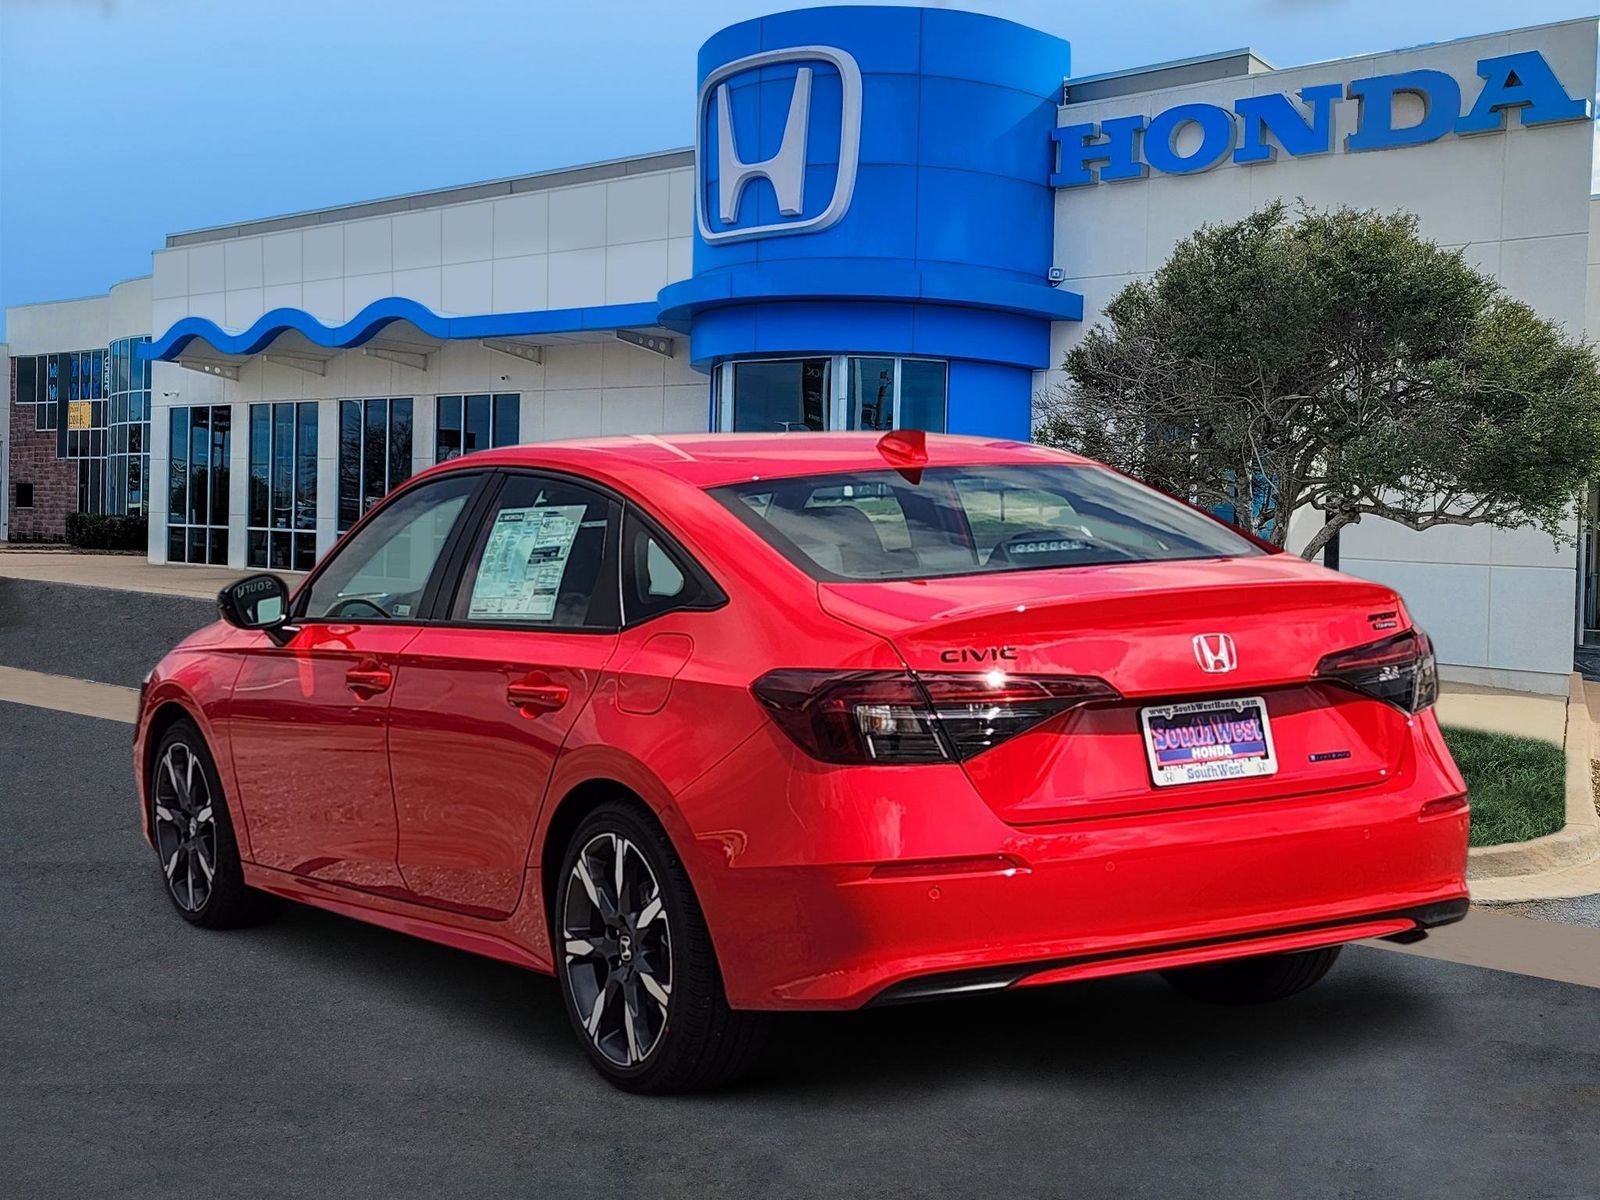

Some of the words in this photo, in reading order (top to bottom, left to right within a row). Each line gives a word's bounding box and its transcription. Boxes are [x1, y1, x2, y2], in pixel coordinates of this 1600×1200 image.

[1050, 50, 1592, 188] HONDA
[941, 647, 1018, 663] CIVIC
[1191, 744, 1233, 759] HONDA
